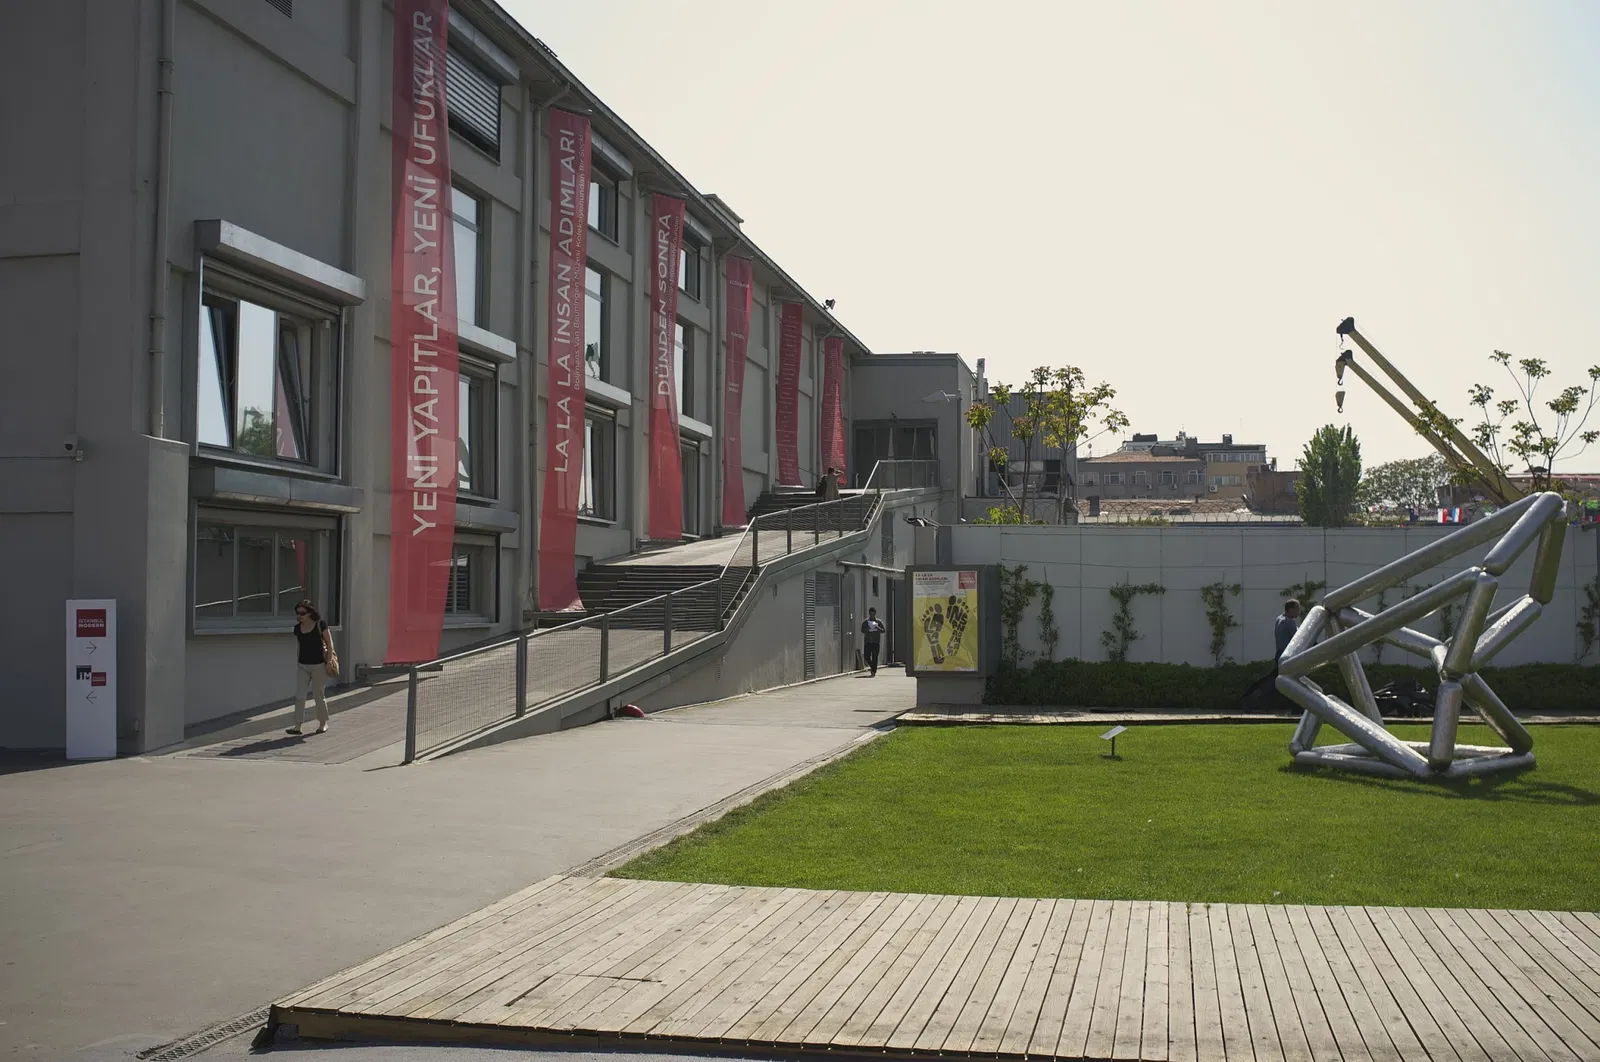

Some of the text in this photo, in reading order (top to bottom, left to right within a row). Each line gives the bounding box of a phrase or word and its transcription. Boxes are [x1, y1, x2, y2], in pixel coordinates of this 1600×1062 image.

[407, 10, 442, 536] YENİ YAPITLAR, YENİ UFUKLAR
[553, 128, 576, 473] LA LA LA İNSAN ADIMLARI
[575, 173, 585, 248] Koleksiyonundan
[573, 282, 581, 329] Beuningen
[655, 214, 672, 396] DÜNDEN SONRA
